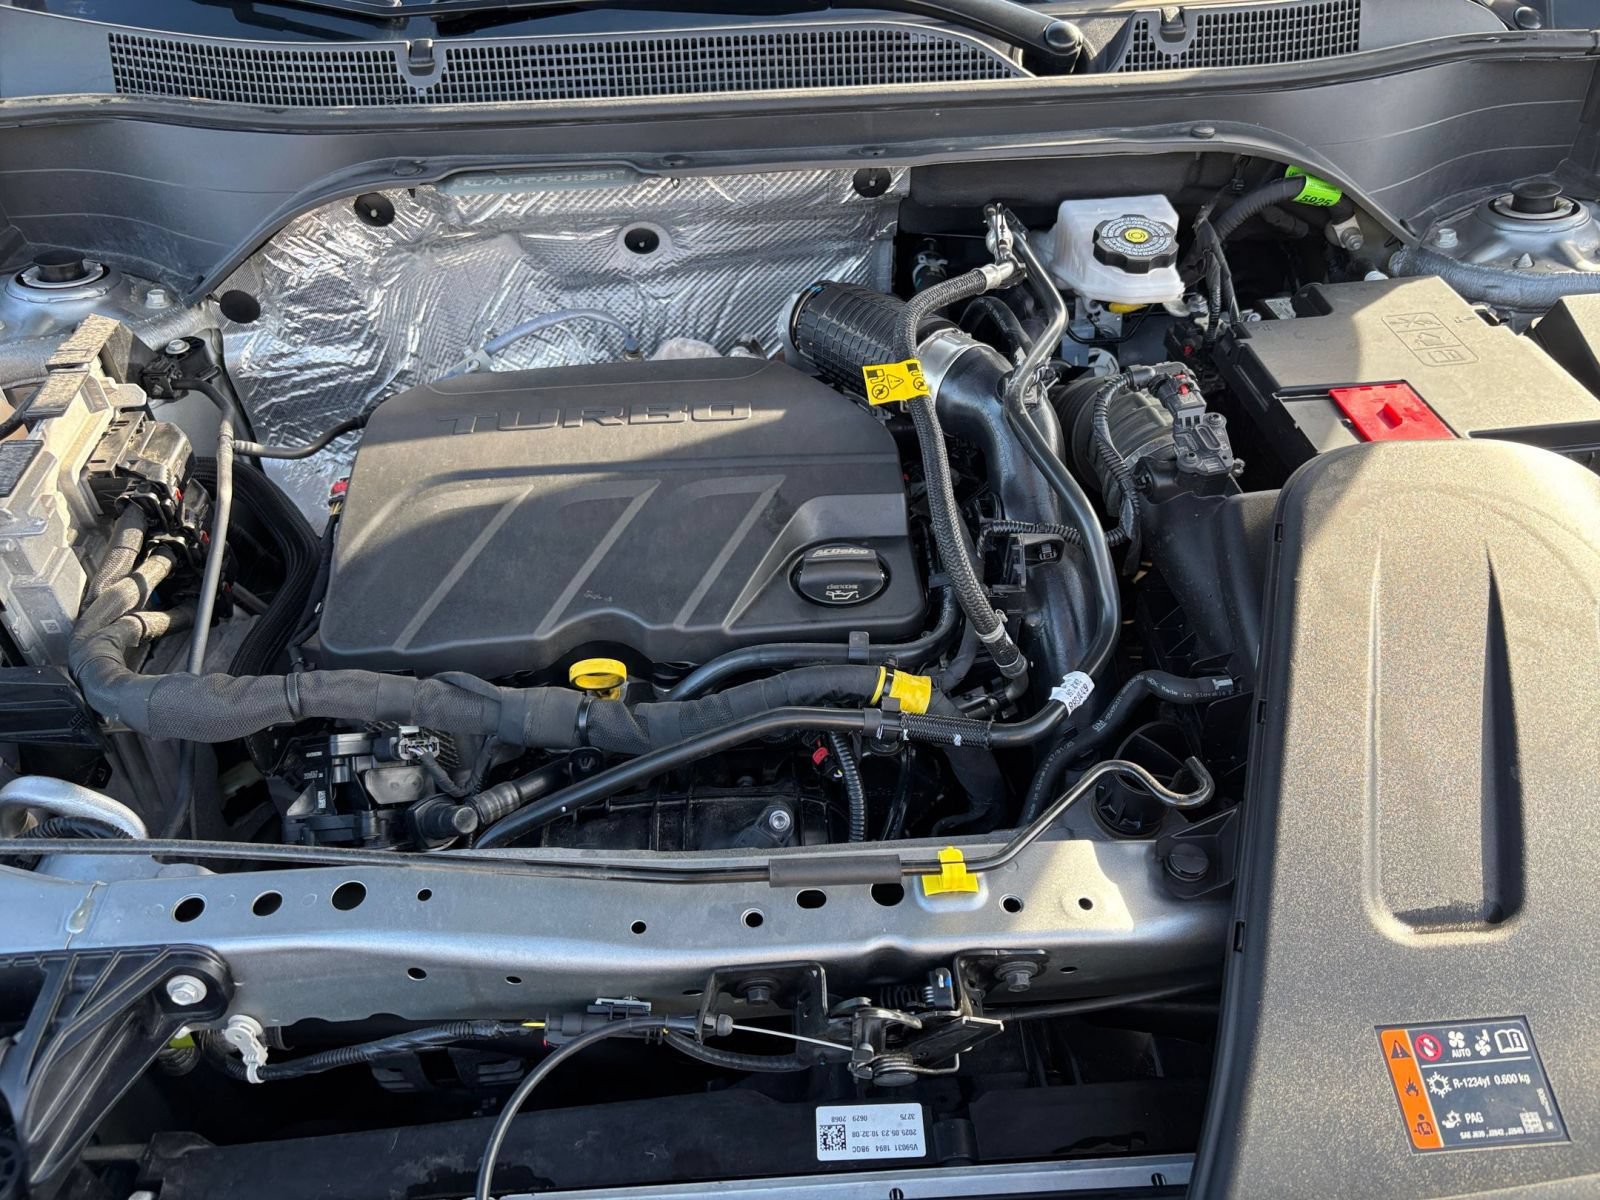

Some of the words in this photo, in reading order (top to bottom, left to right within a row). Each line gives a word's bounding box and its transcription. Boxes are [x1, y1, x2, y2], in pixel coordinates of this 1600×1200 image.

[438, 401, 752, 435] TURBO
[812, 547, 869, 558] ACDelco
[1451, 1048, 1471, 1058] AUTO
[1453, 1075, 1491, 1089] R-1234yf
[1494, 1074, 1518, 1085] 0.600
[1518, 1073, 1530, 1084] kg
[1465, 1112, 1484, 1124] PAG
